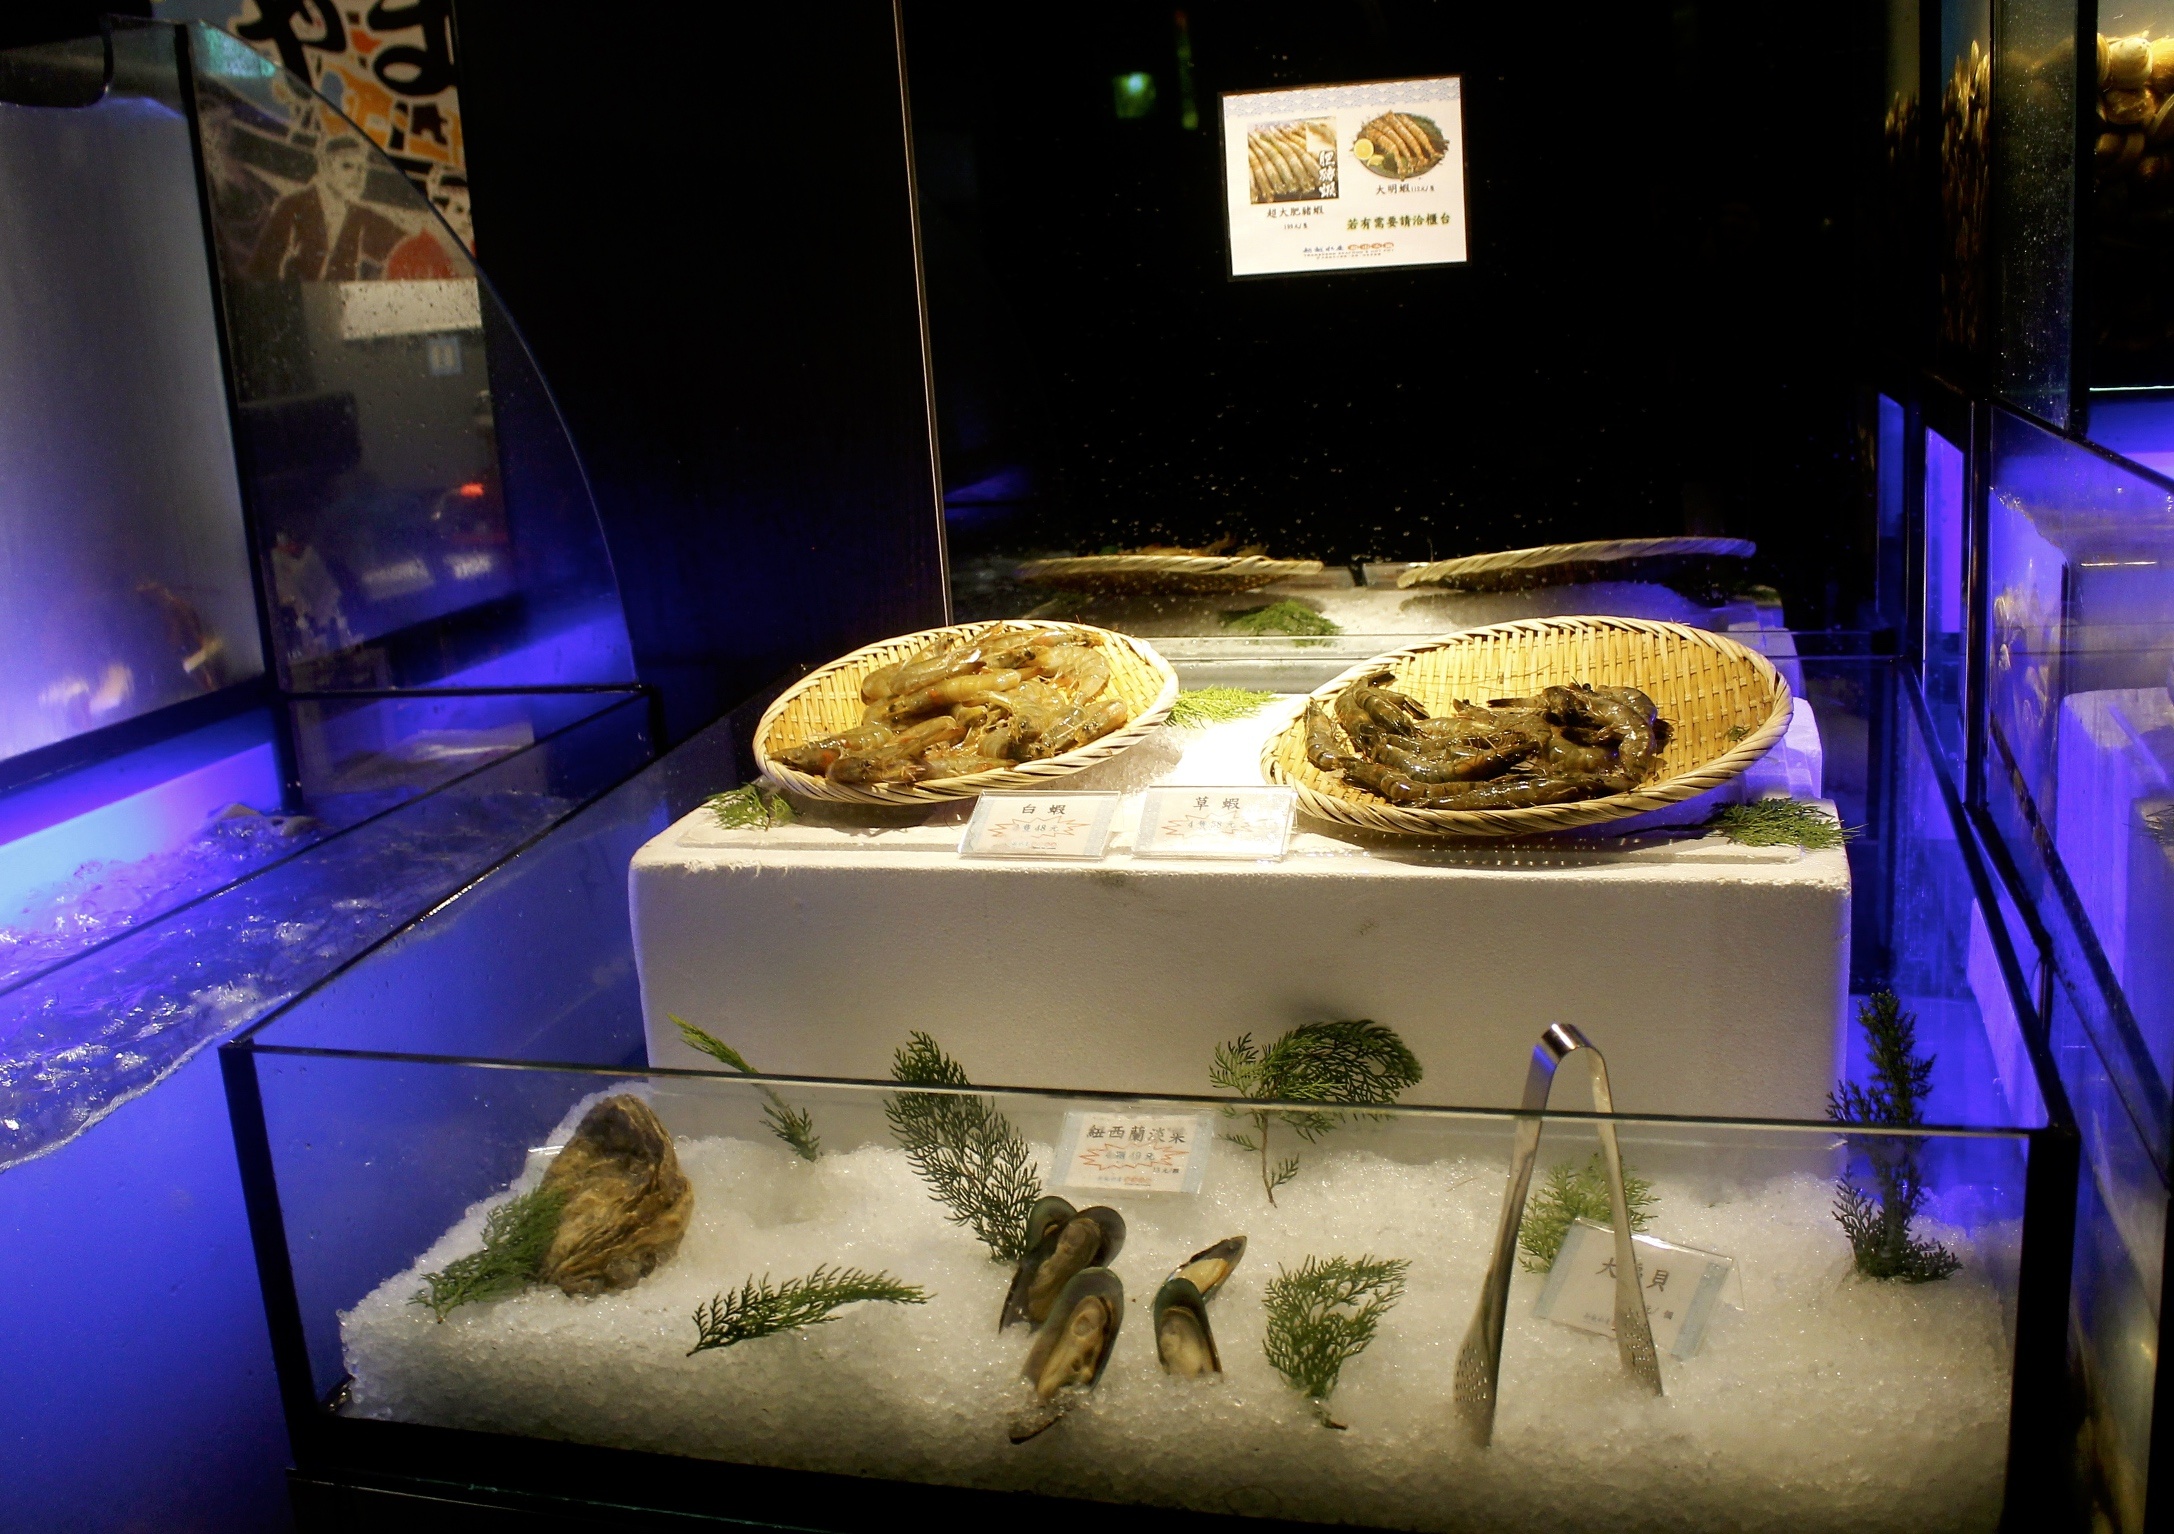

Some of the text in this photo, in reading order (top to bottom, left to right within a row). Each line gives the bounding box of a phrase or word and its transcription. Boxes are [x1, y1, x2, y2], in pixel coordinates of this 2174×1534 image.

[1347, 212, 1451, 231] 若有需要請洽櫃台
[1021, 803, 1067, 815] 白蝦
[1193, 795, 1241, 811] 草蝦
[1595, 1256, 1671, 1293] 大貝
